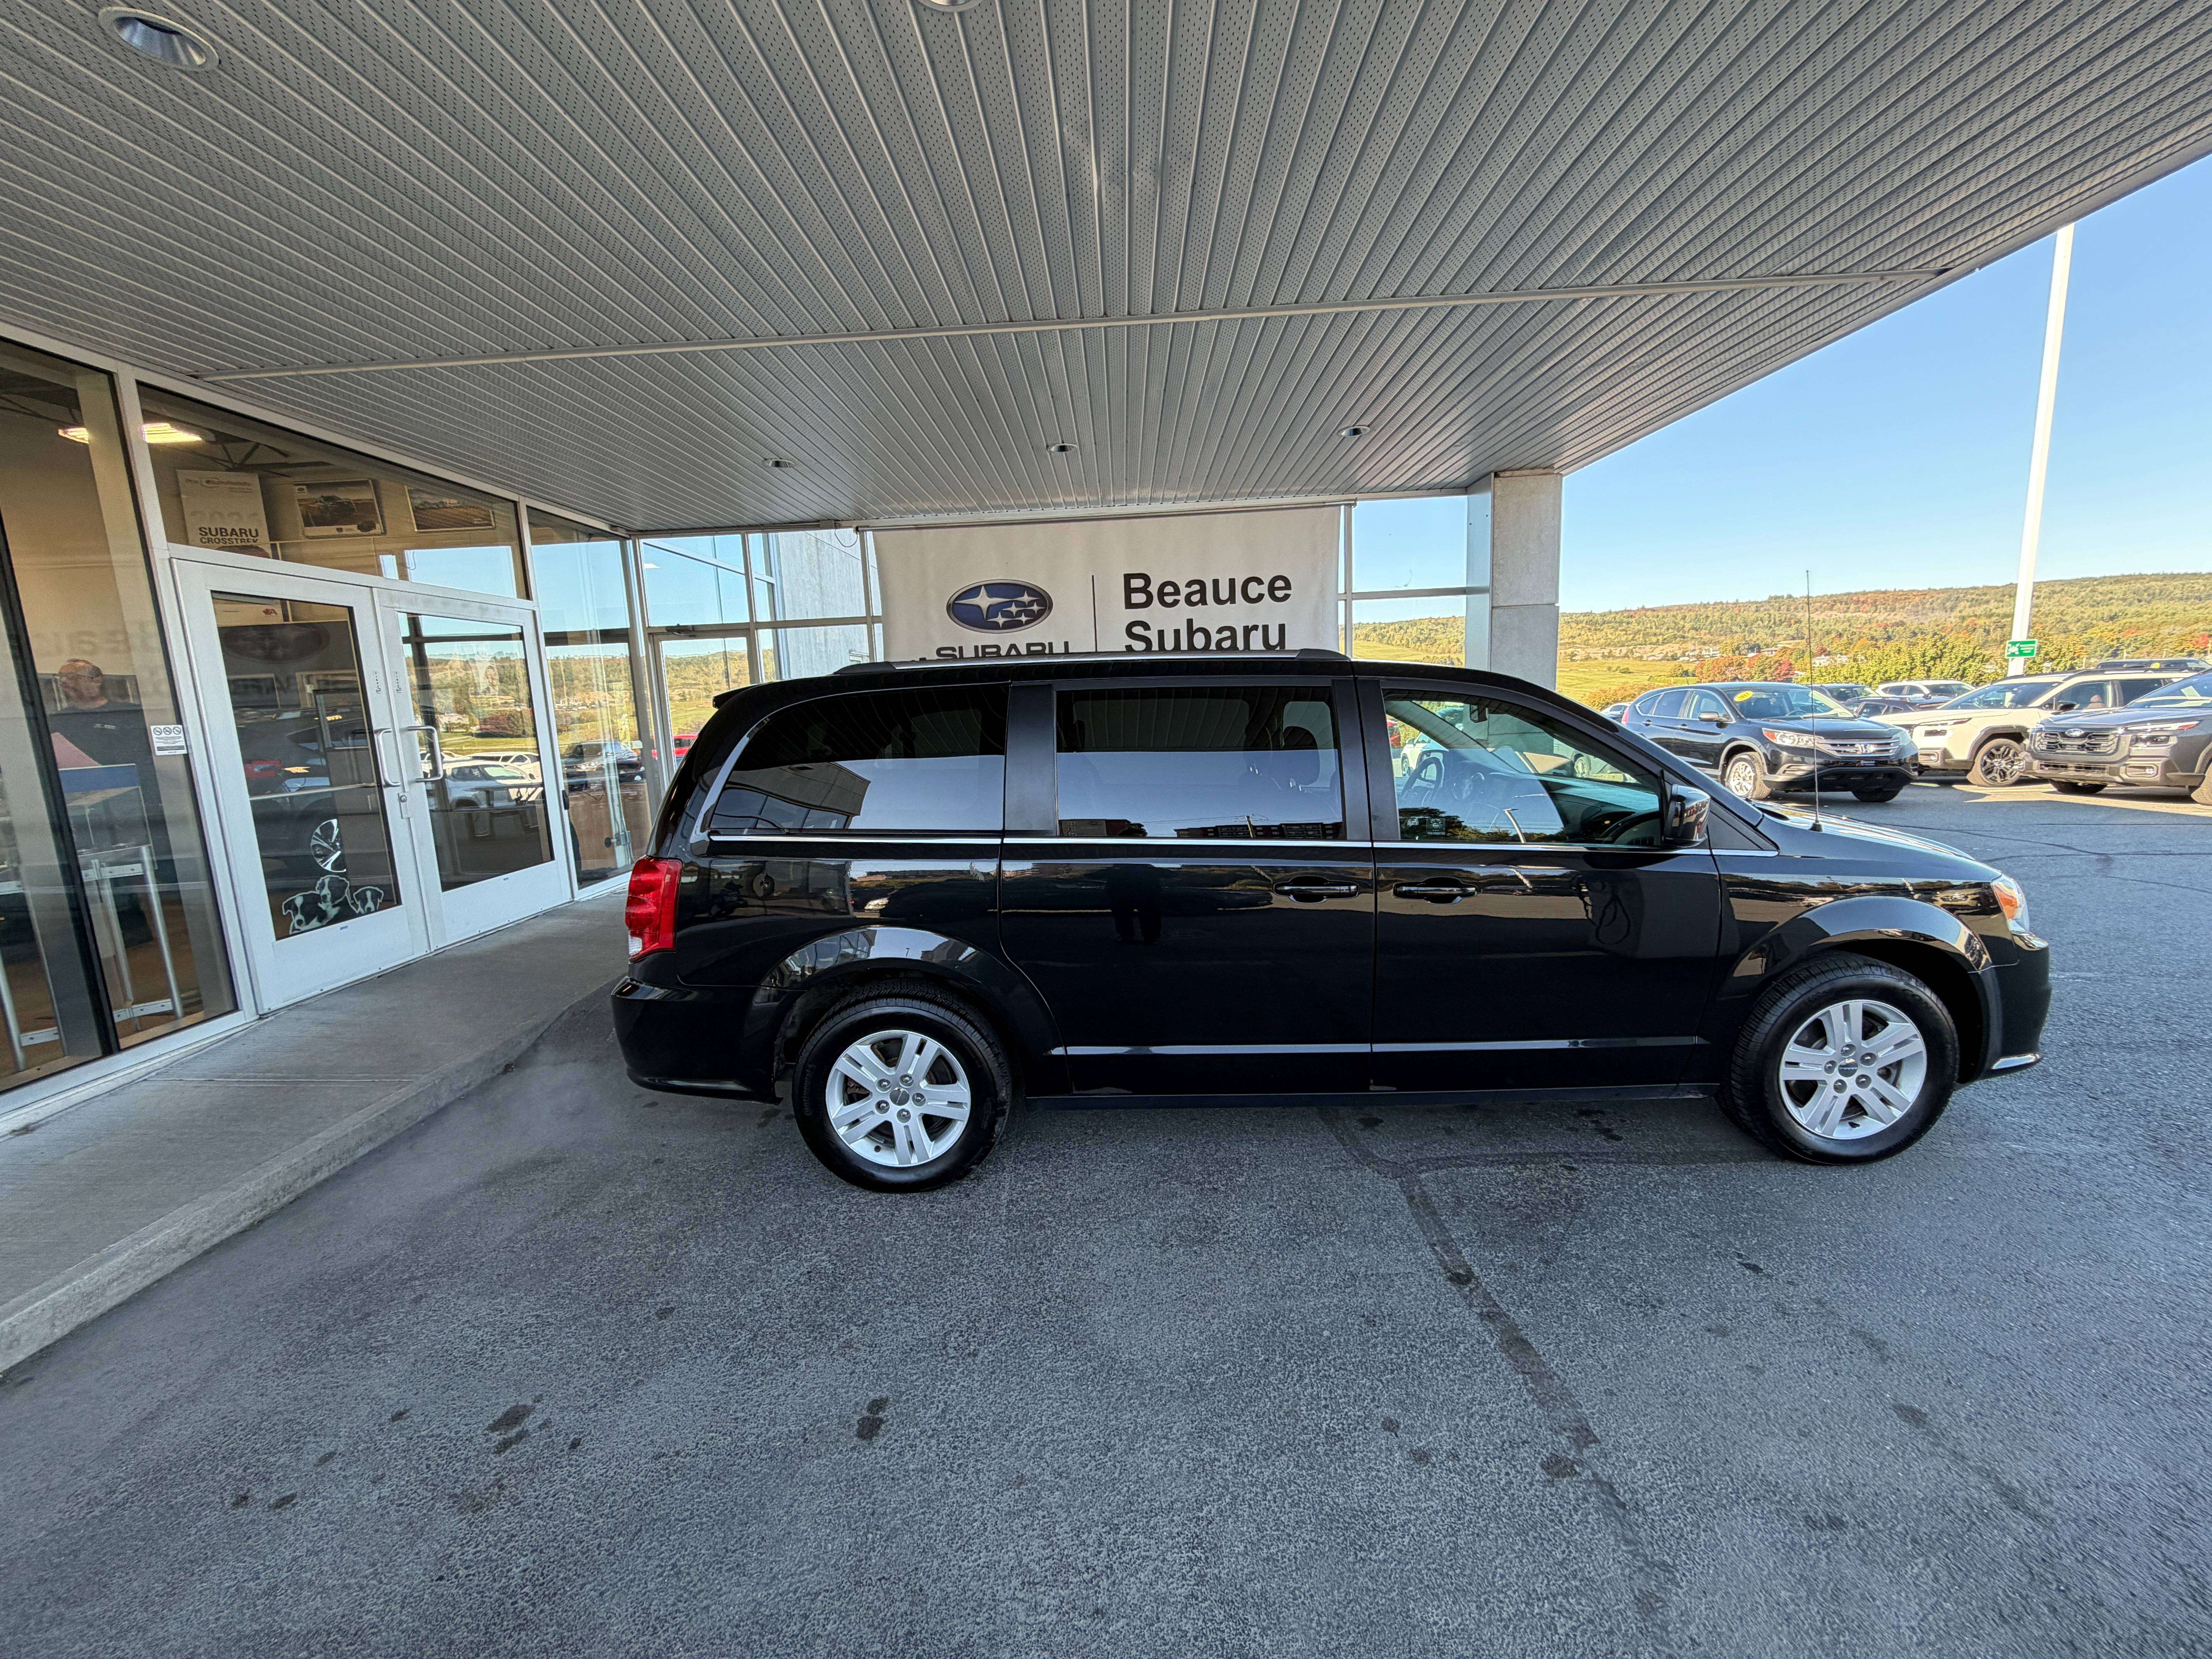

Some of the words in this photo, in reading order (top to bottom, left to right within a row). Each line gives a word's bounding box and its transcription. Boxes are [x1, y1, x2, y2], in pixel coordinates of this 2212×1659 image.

[199, 527, 259, 538] SUBARU
[1123, 573, 1292, 610] Beauce
[1125, 618, 1286, 651] Subaru
